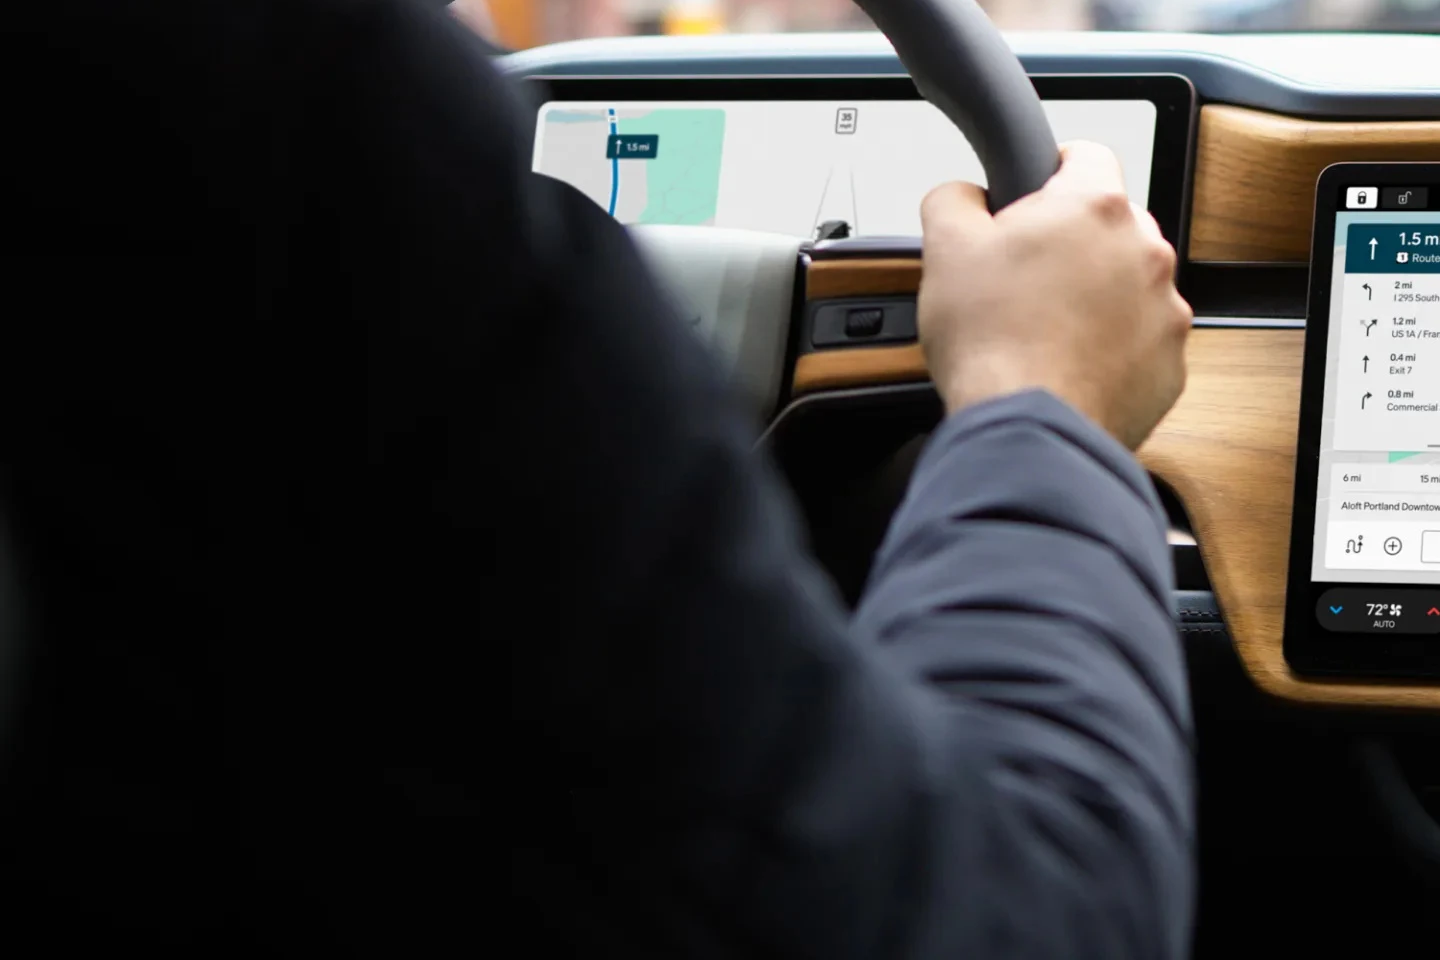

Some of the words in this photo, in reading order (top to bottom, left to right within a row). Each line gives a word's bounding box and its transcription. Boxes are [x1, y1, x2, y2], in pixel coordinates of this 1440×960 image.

[626, 143, 638, 152] 1.5
[638, 143, 650, 151] mi
[1398, 232, 1421, 246] 1.5
[1412, 253, 1440, 263] Route
[1394, 281, 1401, 289] 2
[1402, 281, 1412, 289] mi
[1398, 294, 1413, 302] 295
[1415, 293, 1440, 302] South
[1392, 317, 1404, 325] 1.2
[1405, 317, 1416, 325] mi
[1391, 330, 1405, 338] US
[1406, 330, 1416, 338] 1A
[1390, 353, 1404, 362] 0.4
[1405, 353, 1416, 362] mi
[1389, 366, 1405, 375] Exit
[1407, 366, 1412, 375] 7
[1387, 390, 1401, 399] 0.8
[1402, 390, 1414, 399] mi
[1387, 403, 1438, 412] Commercial
[1343, 474, 1349, 482] 6
[1350, 474, 1361, 482] mi
[1420, 475, 1429, 483] 15
[1341, 502, 1362, 512] Aloft
[1363, 502, 1400, 512] Portland
[1366, 603, 1389, 617] 72°
[1373, 620, 1395, 628] AUTO
